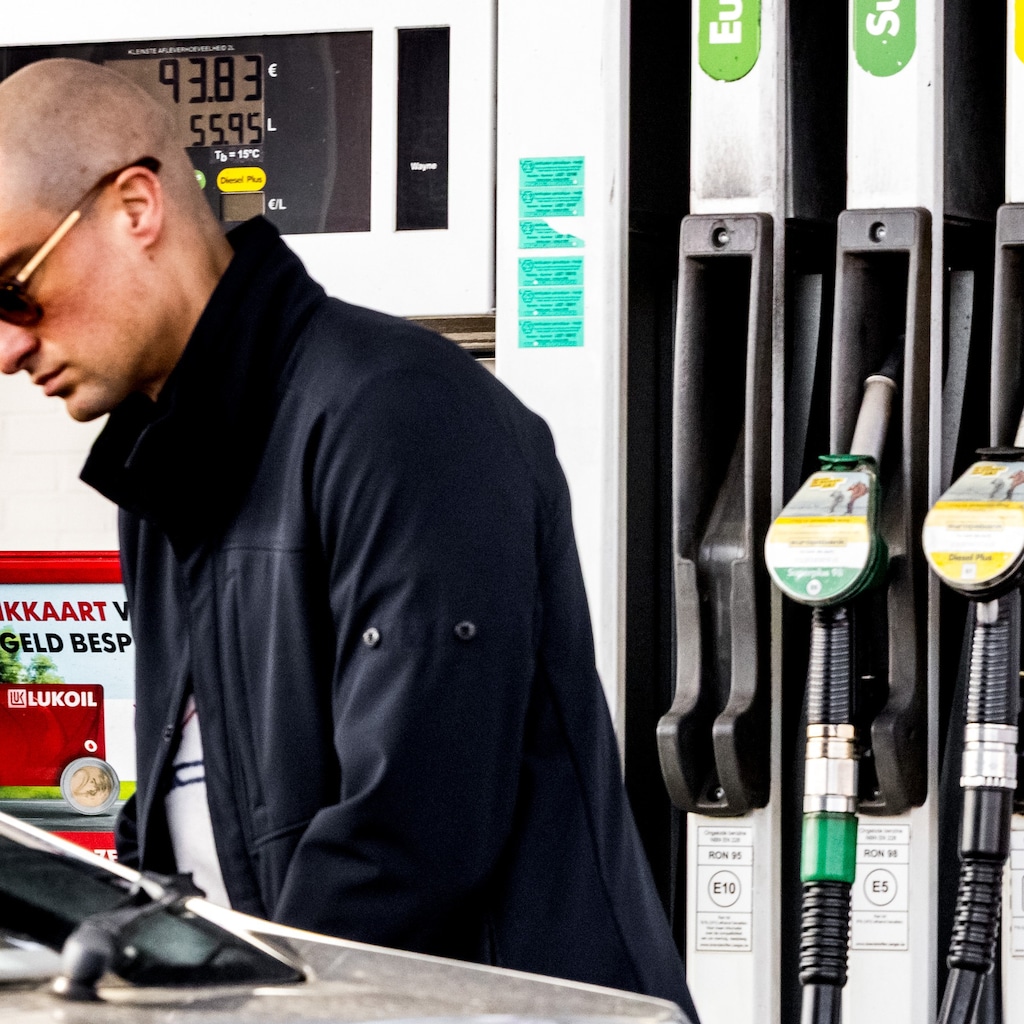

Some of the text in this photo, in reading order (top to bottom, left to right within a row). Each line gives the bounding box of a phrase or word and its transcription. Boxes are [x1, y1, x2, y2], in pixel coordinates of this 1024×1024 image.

[159, 55, 278, 103] 93.83 €
[190, 112, 277, 147] 55.95 L
[410, 162, 438, 171] Wayne
[220, 176, 244, 184] Diesel
[268, 199, 287, 210] €/L
[0, 632, 132, 653] GELD BESP
[28, 691, 97, 707] LUKOIL
[709, 851, 742, 860] RON 95
[864, 849, 898, 858] RON 98
[713, 882, 736, 894] E10
[872, 880, 889, 893] E5
